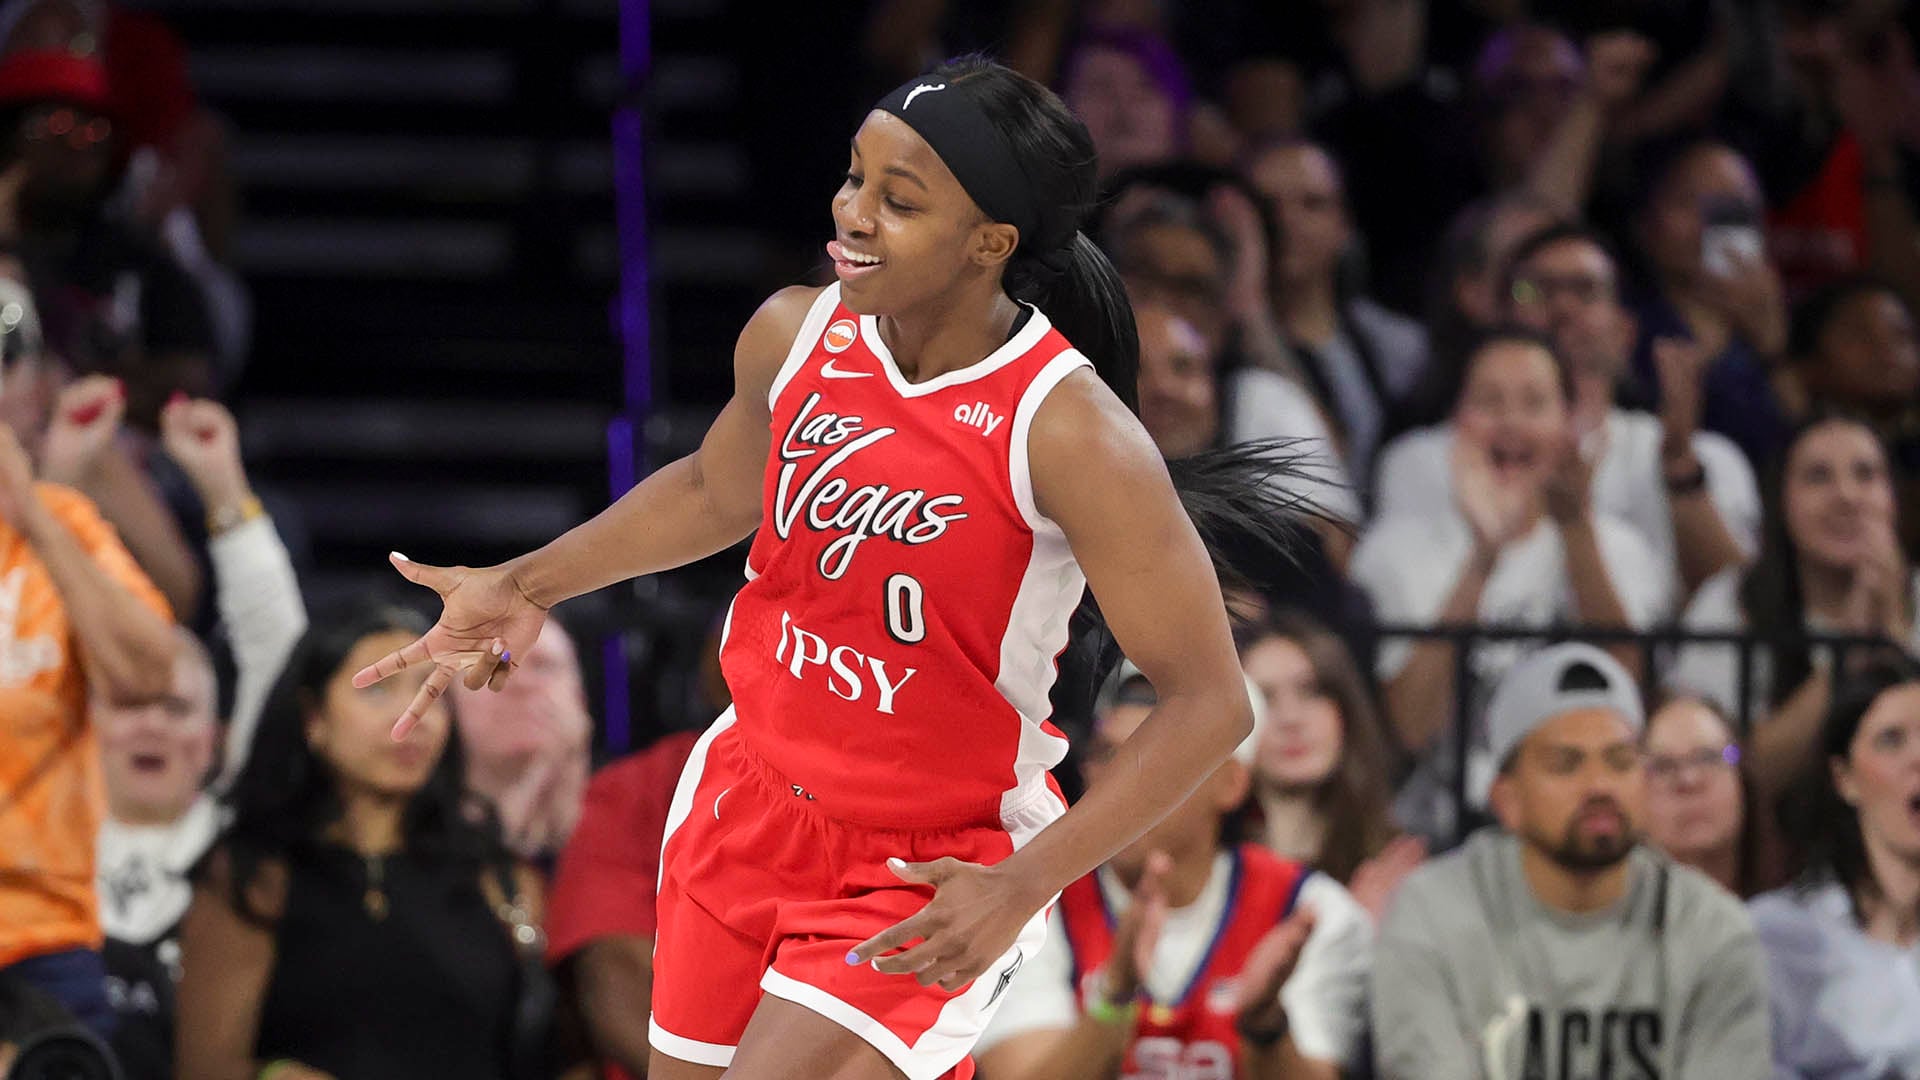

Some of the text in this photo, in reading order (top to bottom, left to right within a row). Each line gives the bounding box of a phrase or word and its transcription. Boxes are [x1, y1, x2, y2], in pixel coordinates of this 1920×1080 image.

[780, 392, 863, 461] Las
[953, 401, 1005, 436] ally
[775, 427, 969, 579] Vegas
[884, 573, 926, 644] 0
[776, 611, 917, 714] IPSY
